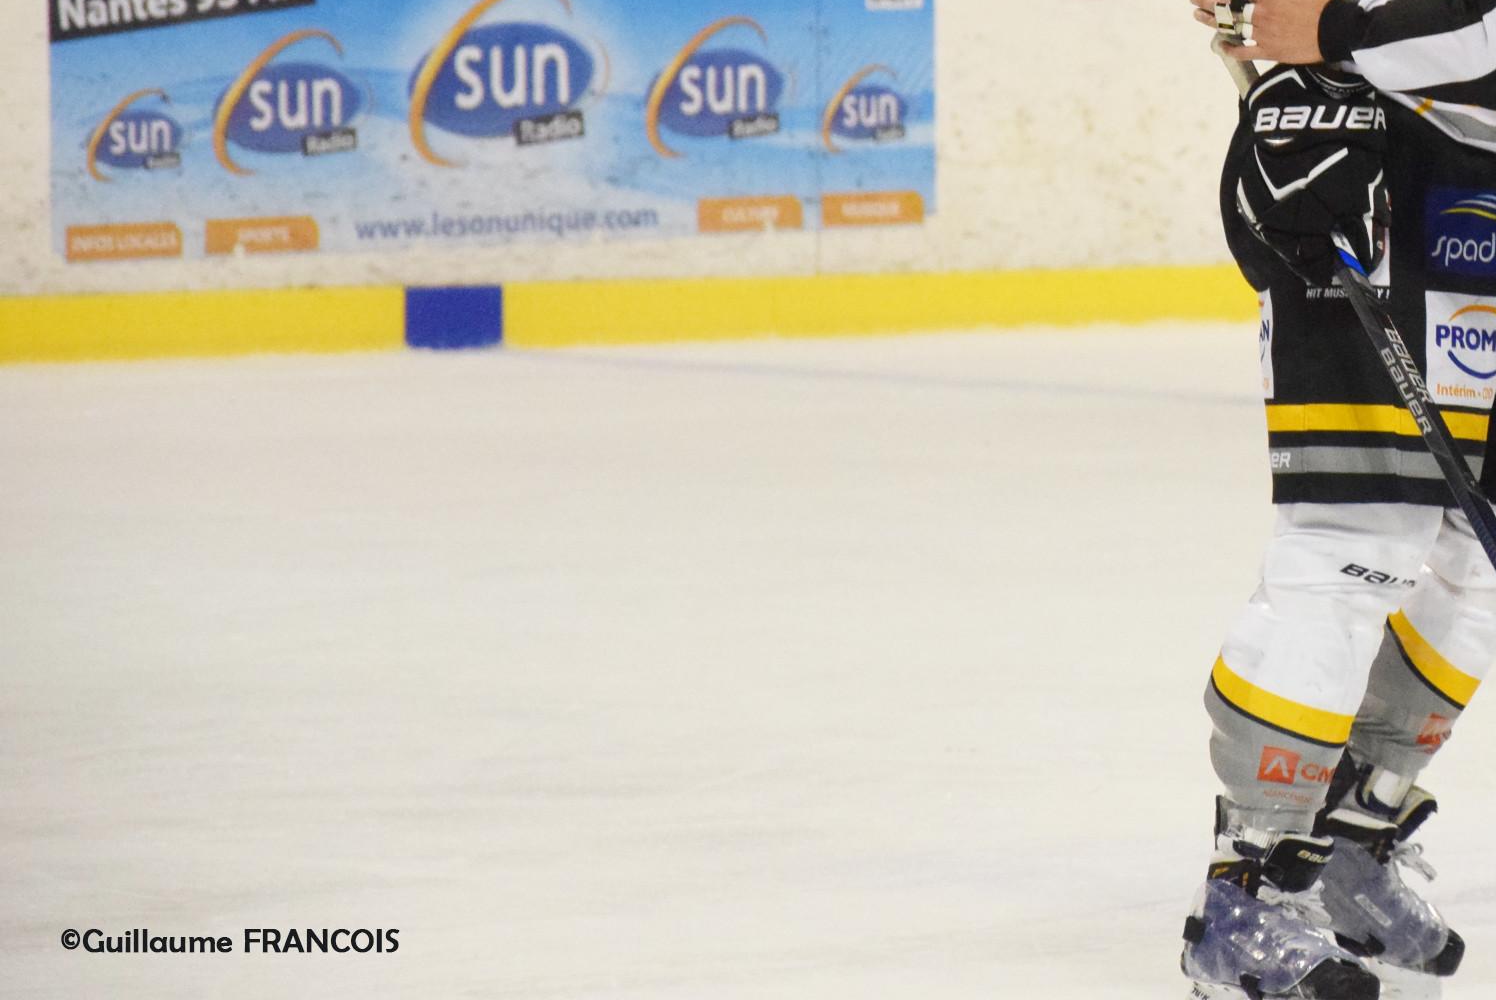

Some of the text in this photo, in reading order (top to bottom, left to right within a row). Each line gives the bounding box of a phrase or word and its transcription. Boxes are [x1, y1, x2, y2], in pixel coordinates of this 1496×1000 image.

[453, 42, 572, 112] sun
[679, 64, 768, 117] sun
[249, 76, 344, 132] sun
[842, 93, 899, 129] sun
[107, 119, 173, 156] sun
